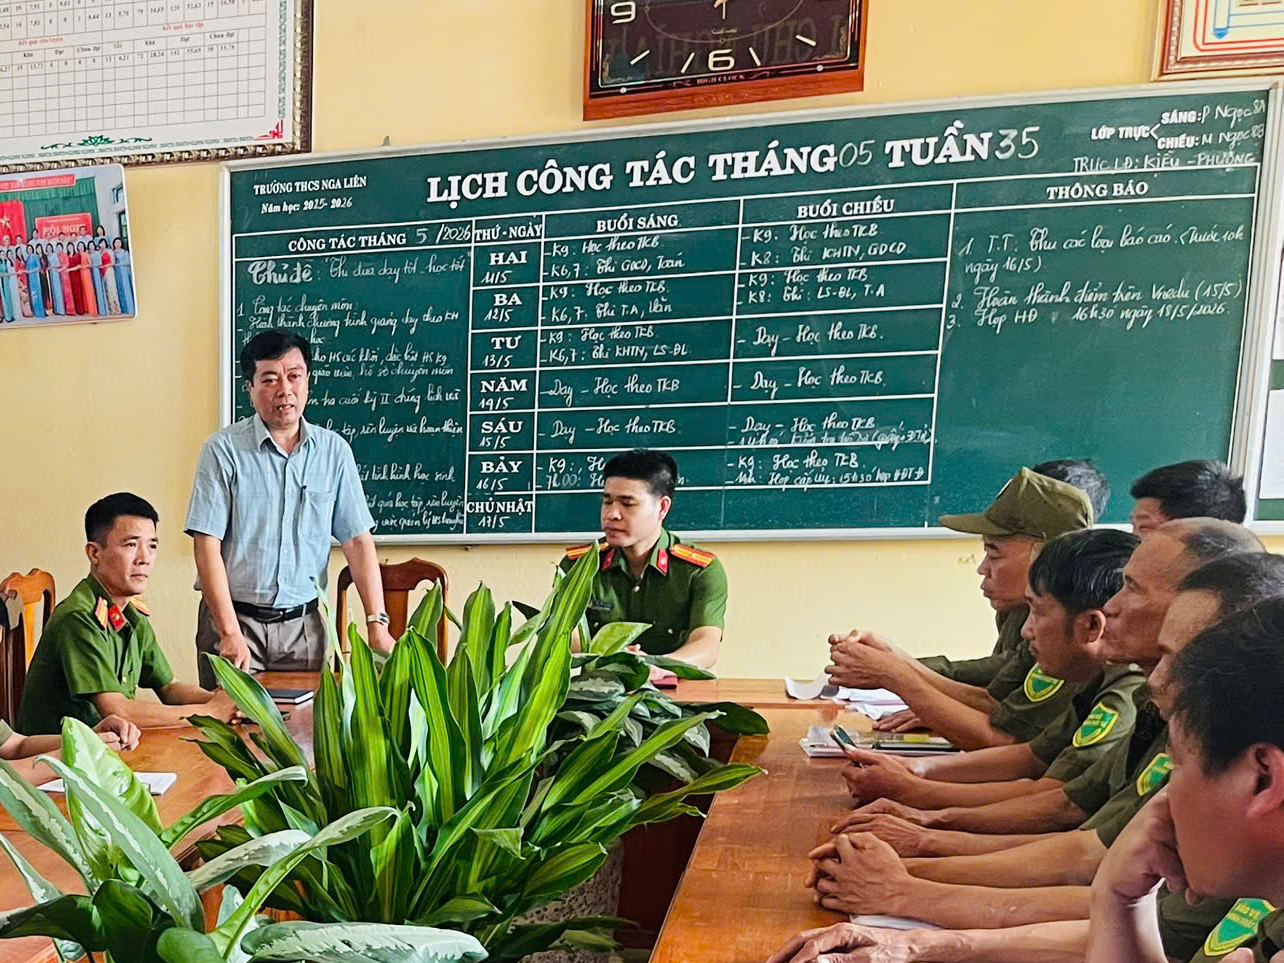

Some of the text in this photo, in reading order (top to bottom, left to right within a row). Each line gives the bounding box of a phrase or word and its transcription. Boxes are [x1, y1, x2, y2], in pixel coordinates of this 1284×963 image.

[610, 2, 635, 24] 9
[708, 49, 735, 72] 6
[994, 126, 1040, 160] 35
[1091, 125, 1150, 141] LỚP TRỰC
[838, 139, 875, 168] 05
[884, 120, 992, 168] TUẦN
[254, 174, 367, 195] TRƯỜNG THCS NGA LIÊN
[427, 140, 837, 209] LỊCH CÔNG TÁC THÁNG
[1046, 180, 1149, 201] THÔNG BÁO
[261, 202, 281, 214] Năm
[596, 212, 678, 233] BUỔI SÁNG
[288, 231, 406, 252] CÔNG TÁC THÁNG
[489, 251, 528, 266] HAI
[493, 293, 522, 307] BA
[491, 335, 521, 350] TƯ
[482, 354, 513, 368] 13/5
[480, 376, 528, 392] NĂM
[481, 417, 523, 433] SÁU
[481, 455, 522, 474] BẢY
[466, 498, 496, 513] CHỦ
[496, 499, 533, 515] NHẬT
